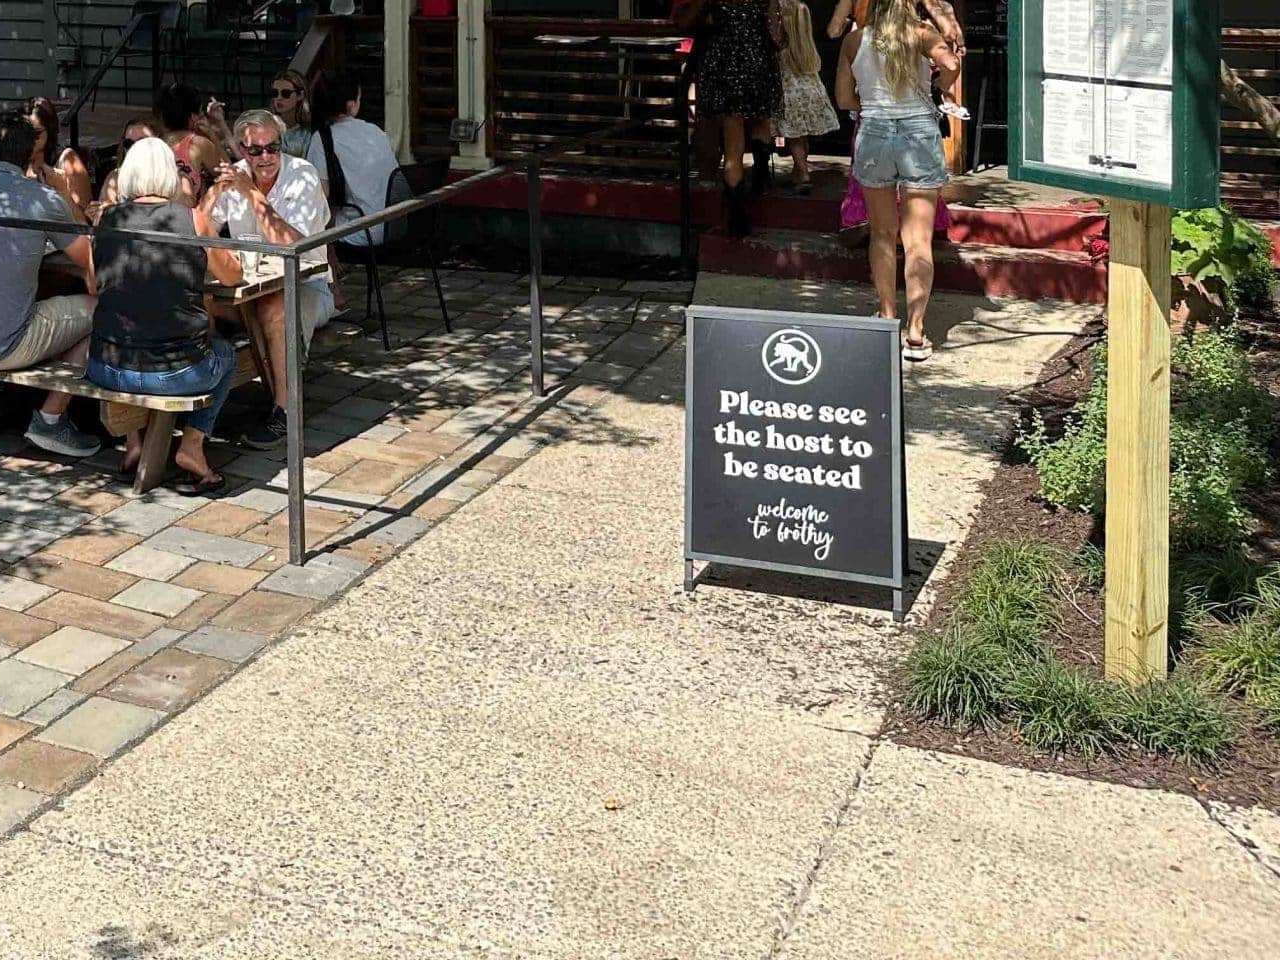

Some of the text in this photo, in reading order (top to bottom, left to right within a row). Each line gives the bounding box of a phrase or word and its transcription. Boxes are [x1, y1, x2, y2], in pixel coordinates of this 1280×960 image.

[720, 390, 867, 426] Please see
[713, 420, 873, 458] the host to
[723, 451, 863, 490] be seated
[757, 497, 829, 523] welcome
[747, 515, 834, 561] to frothy
